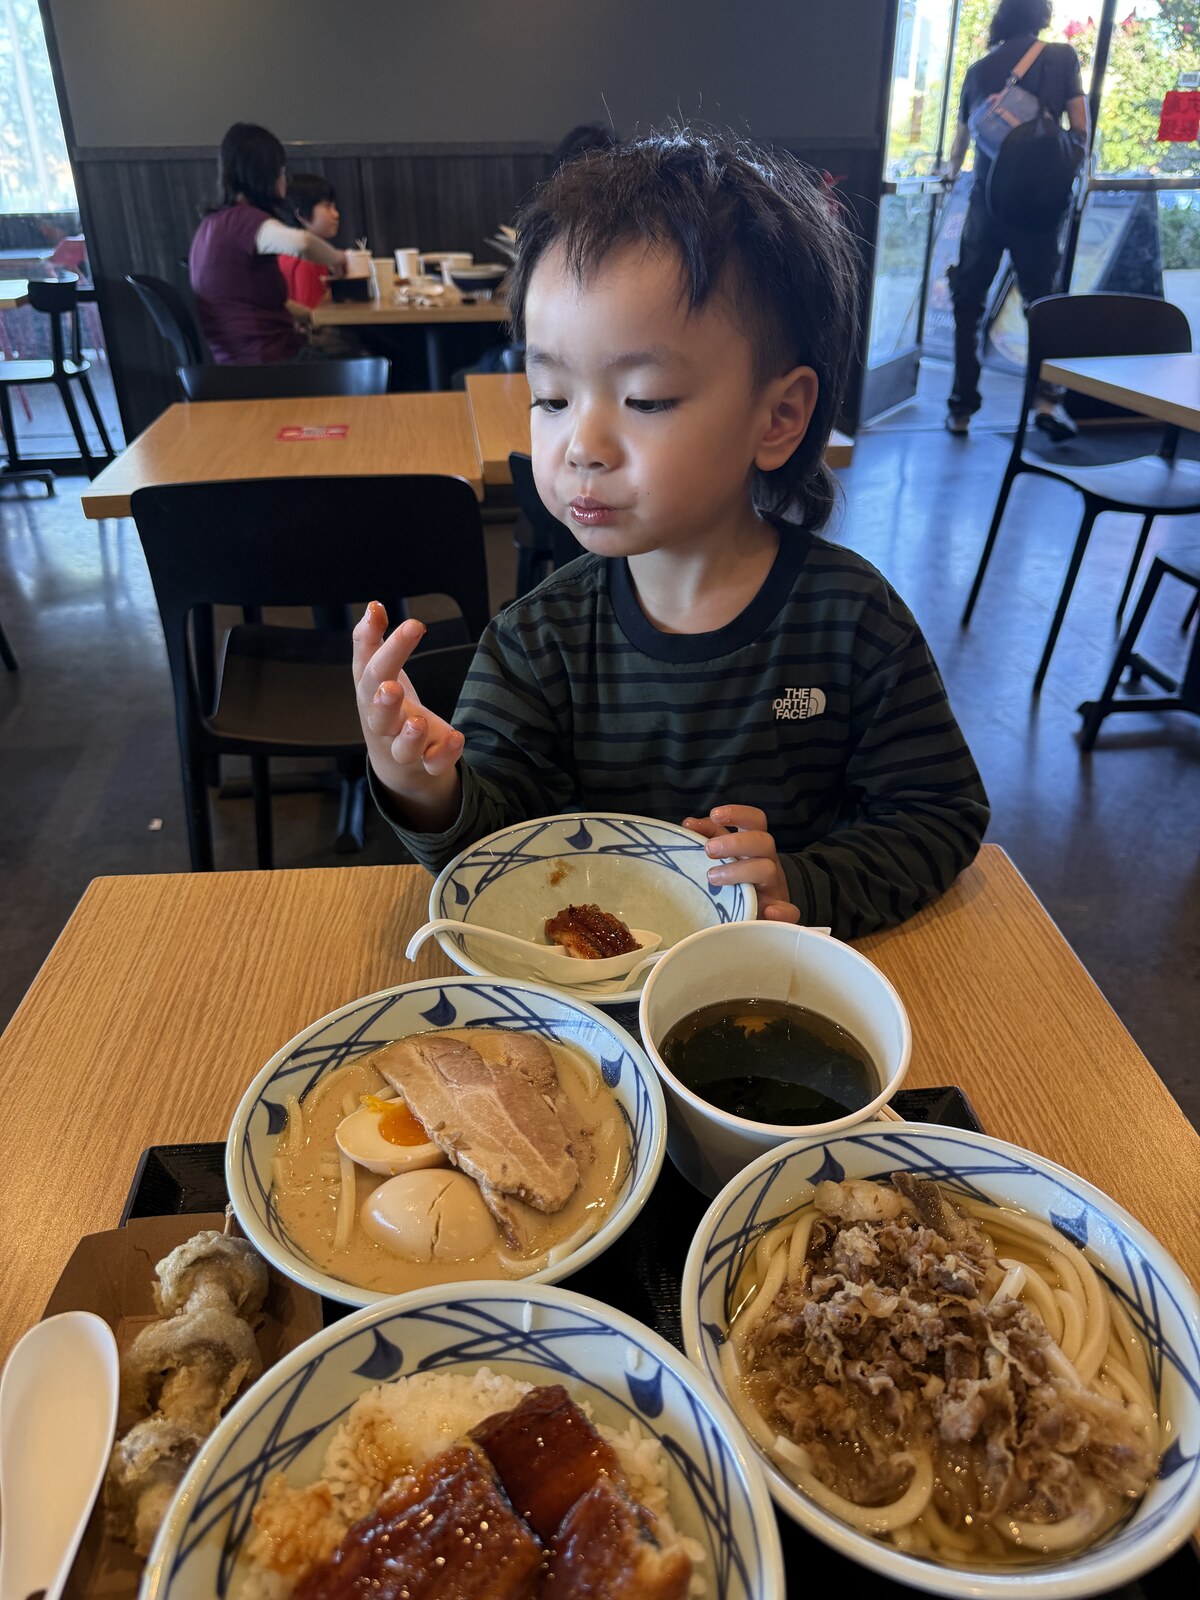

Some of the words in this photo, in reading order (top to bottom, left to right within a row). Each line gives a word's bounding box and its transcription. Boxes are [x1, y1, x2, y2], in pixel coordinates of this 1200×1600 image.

[785, 688, 810, 698] THE
[772, 699, 809, 710] ORTH
[776, 709, 807, 720] FACE
